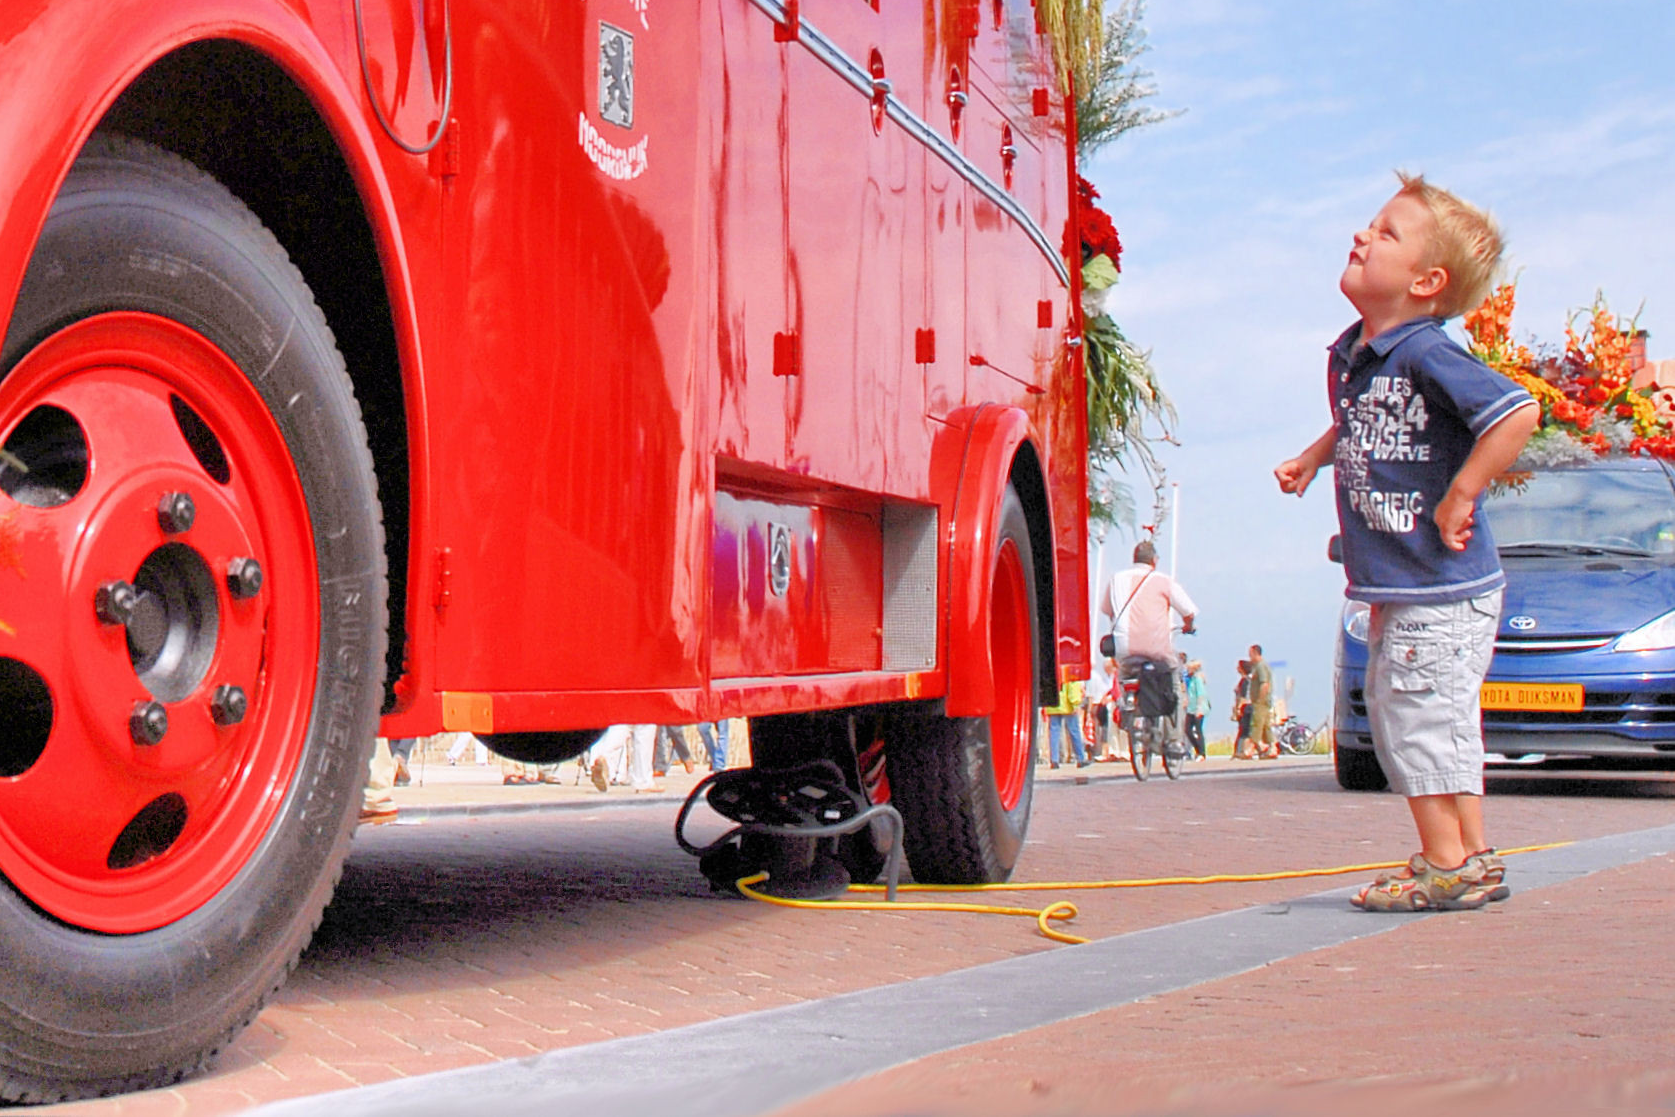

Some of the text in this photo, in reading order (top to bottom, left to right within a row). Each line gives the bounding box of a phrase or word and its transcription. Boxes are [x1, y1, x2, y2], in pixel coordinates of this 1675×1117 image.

[1374, 444, 1430, 461] WAVE
[1349, 490, 1423, 514] PACIFIC
[1518, 690, 1576, 704] DIJKSMAN
